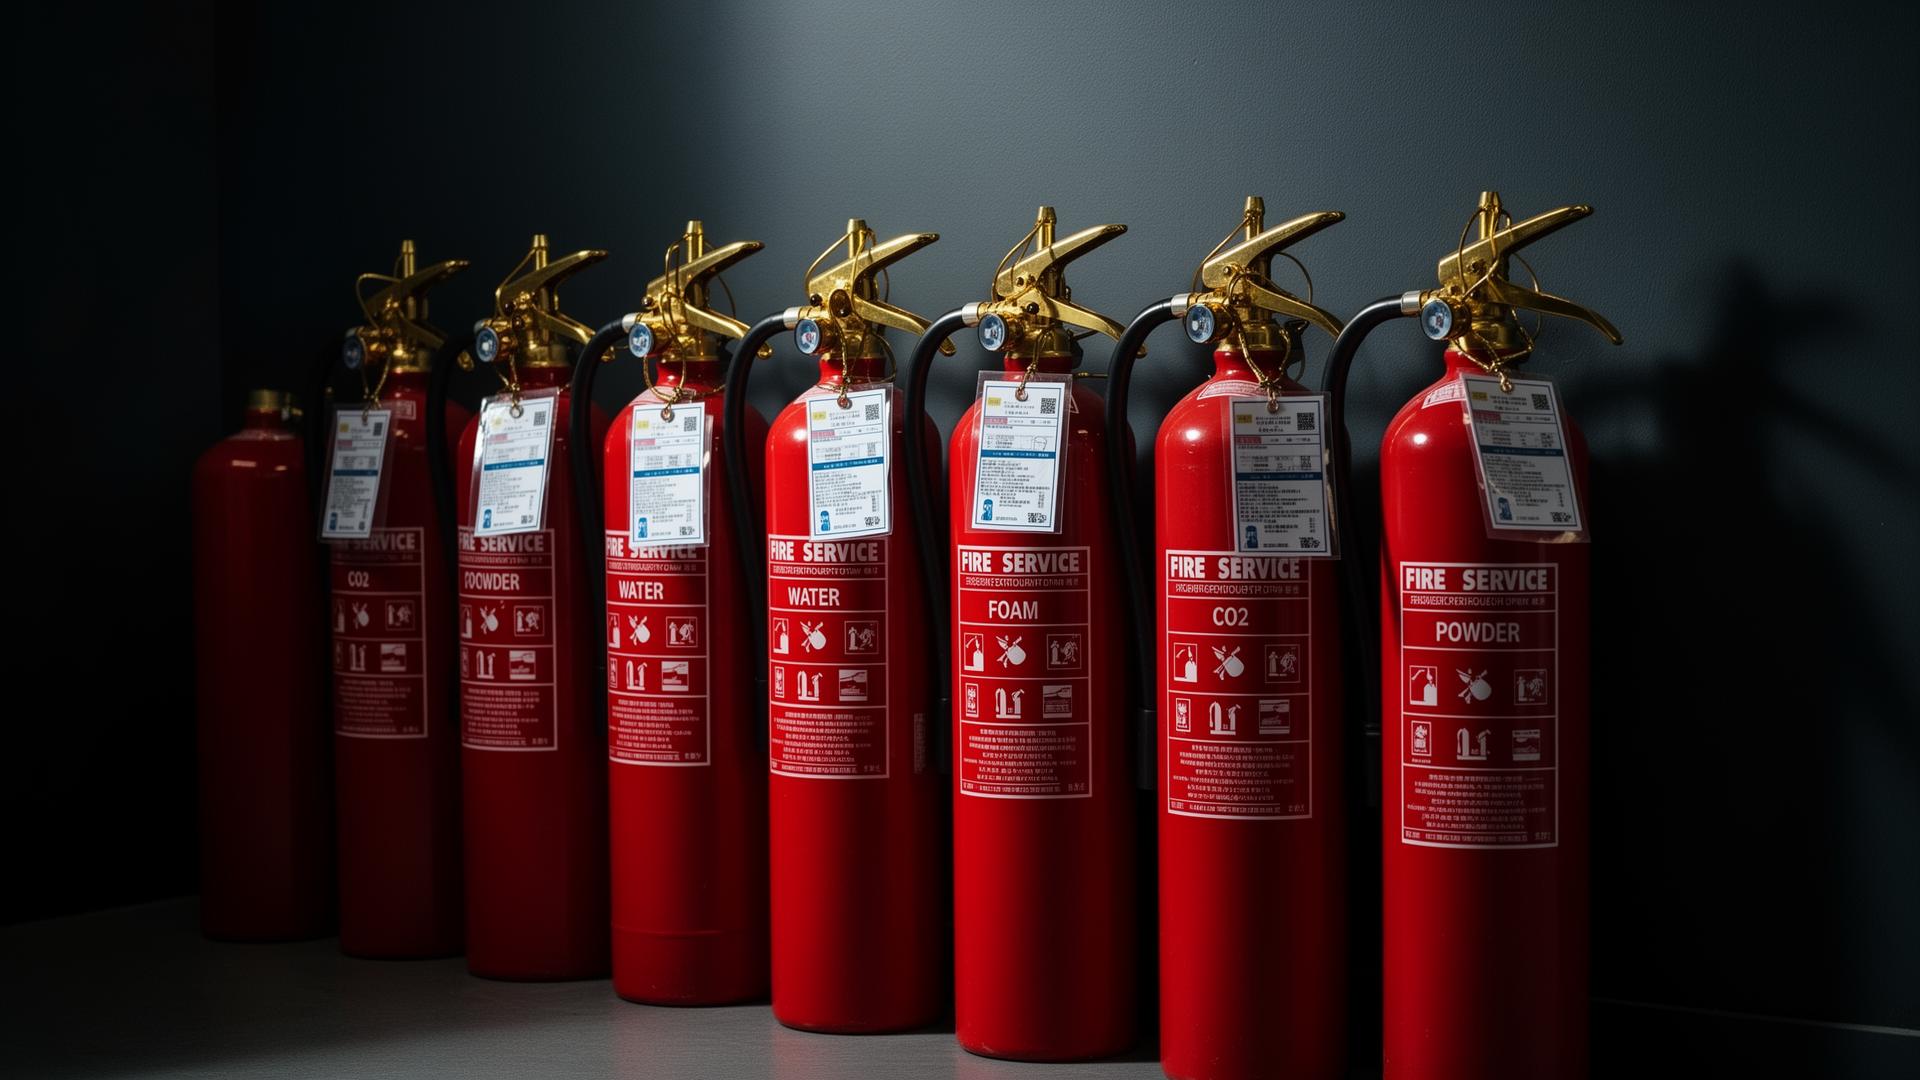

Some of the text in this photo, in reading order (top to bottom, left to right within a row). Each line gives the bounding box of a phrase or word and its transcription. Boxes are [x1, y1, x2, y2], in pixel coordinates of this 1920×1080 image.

[480, 533, 545, 553] SERVICE
[770, 542, 879, 562] FIRE SERVICE
[962, 552, 1080, 573] FIRE SERVICE
[1170, 556, 1300, 579] FIRE SERVICE
[347, 570, 370, 588] CO2
[1405, 567, 1548, 591] FIRE SERVICE
[618, 580, 664, 600] WATER
[787, 587, 840, 606] WATER
[988, 600, 1039, 620] FOAM
[1212, 606, 1249, 627] CO2
[1435, 620, 1521, 643] POWDER
